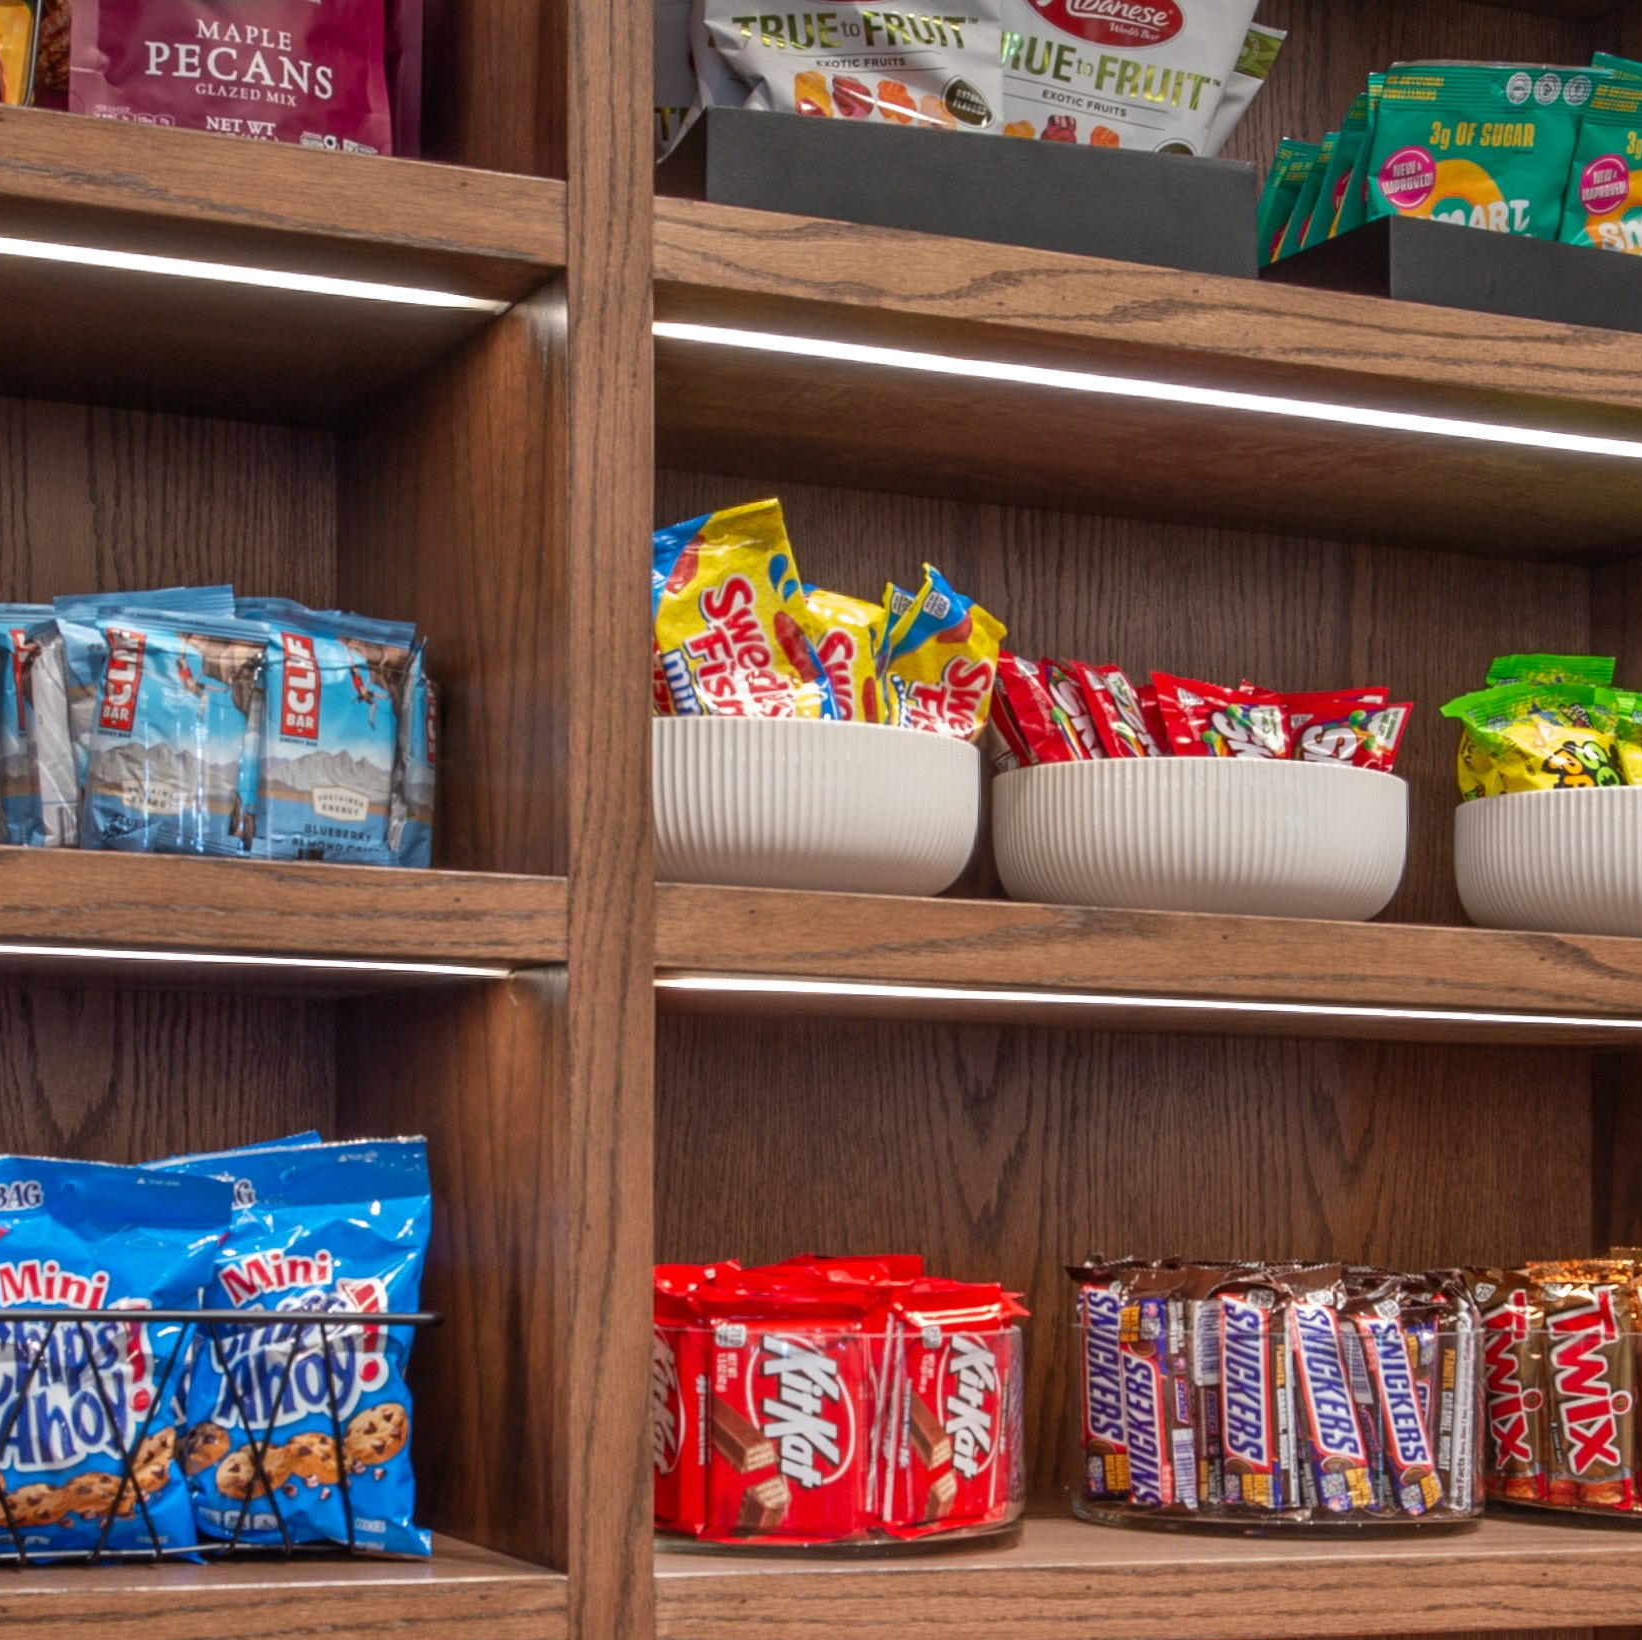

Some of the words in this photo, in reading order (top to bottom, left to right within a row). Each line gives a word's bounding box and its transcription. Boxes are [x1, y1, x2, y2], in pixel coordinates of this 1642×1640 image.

[196, 19, 292, 51] MAPLE
[733, 15, 839, 49] TRUE
[843, 21, 861, 38] to
[863, 10, 964, 49] FRUIT
[145, 41, 332, 100] PECANS
[816, 55, 856, 69] EXOTIC
[860, 56, 906, 67] FRUITS
[196, 83, 260, 100] GLAZED
[266, 93, 297, 107] MIX
[1042, 89, 1083, 108] EXOTIC
[1087, 101, 1127, 117] FRUITS
[206, 116, 242, 133] NET
[247, 122, 276, 135] WT
[1430, 122, 1450, 150] 3g
[1455, 122, 1474, 147] OF
[1479, 123, 1535, 148] SUGAR
[1393, 161, 1417, 179] NEW
[1383, 175, 1433, 197] IMPROVED!
[106, 627, 142, 707] CLIF
[287, 635, 316, 711] CLIF
[102, 705, 130, 722] BAR
[286, 715, 315, 729] BAR
[321, 803, 359, 816] ENERGY
[220, 1251, 333, 1306] Mini
[1222, 1302, 1268, 1464] SNICKERS
[1295, 1306, 1362, 1461] SNICKERS
[1369, 1320, 1434, 1466] SNICKERS
